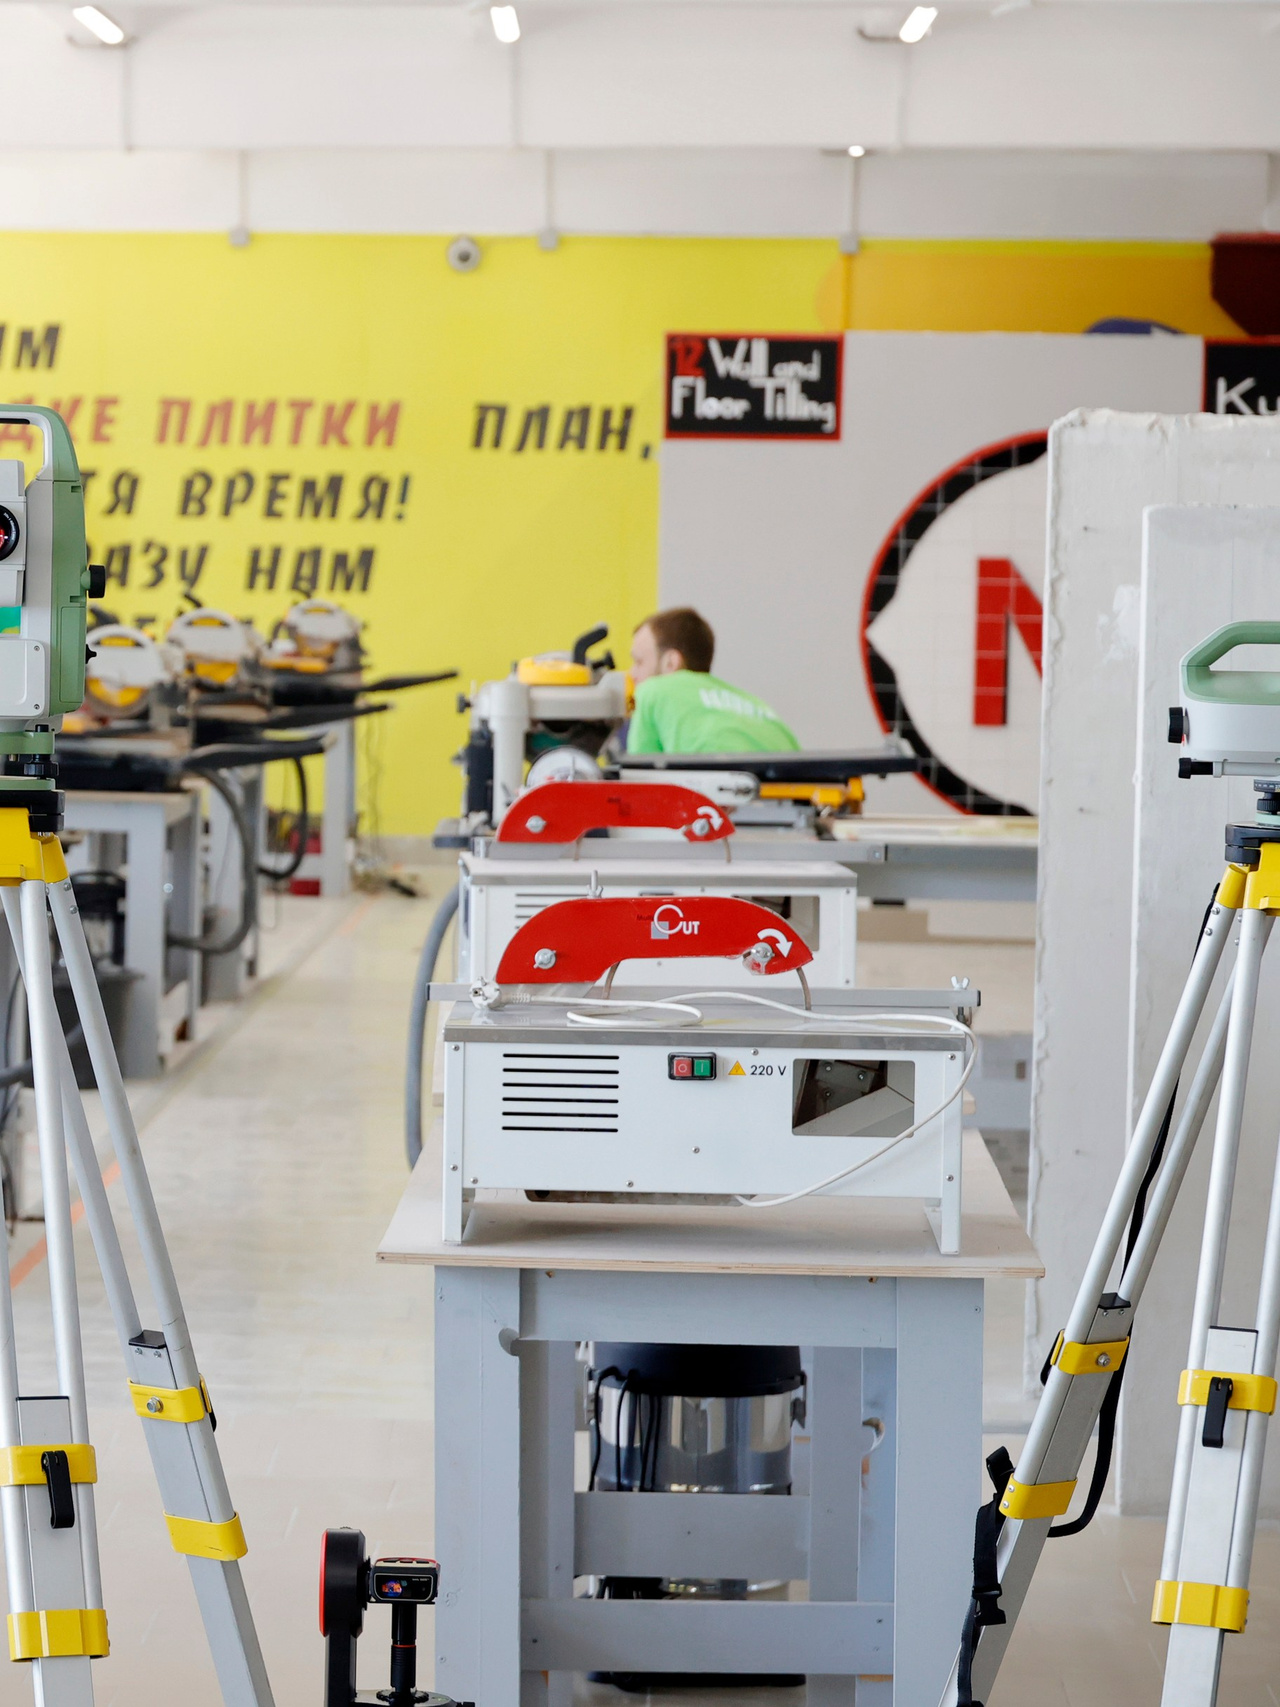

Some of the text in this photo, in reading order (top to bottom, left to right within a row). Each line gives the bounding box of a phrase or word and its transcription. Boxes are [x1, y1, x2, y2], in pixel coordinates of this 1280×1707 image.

[708, 337, 769, 379] Wall
[773, 349, 820, 382] and
[672, 375, 751, 420] Floor
[156, 397, 402, 449] ПЛИТКИ
[472, 403, 651, 460] ПЛАН,
[180, 470, 411, 523] ВРЕМЯ!
[247, 547, 375, 592] НАМ
[750, 1065, 787, 1076] 220 V
